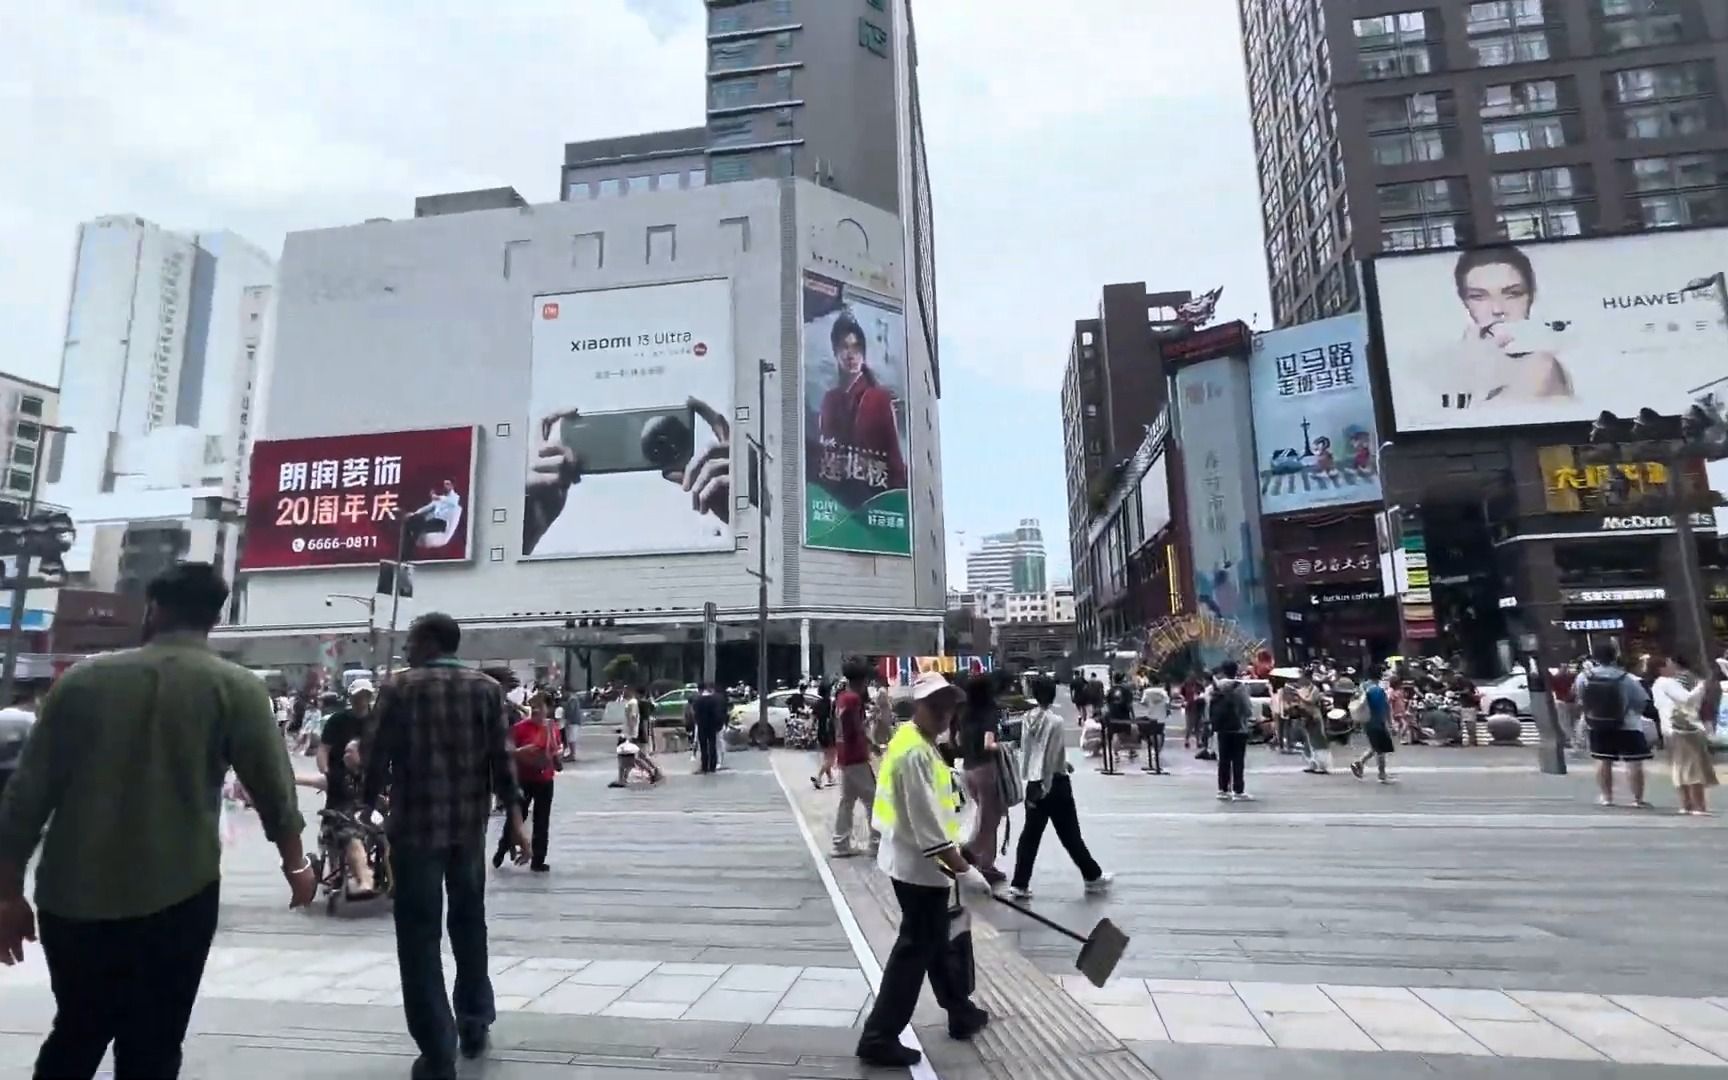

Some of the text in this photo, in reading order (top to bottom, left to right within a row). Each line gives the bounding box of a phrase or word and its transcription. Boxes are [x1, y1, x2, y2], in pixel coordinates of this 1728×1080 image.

[1602, 291, 1685, 309] HUAWEI
[570, 331, 692, 352] xiaomi 13 Ultra
[1275, 341, 1354, 380] 过马路
[1277, 367, 1355, 397] 走斑马线
[278, 455, 402, 492] 朗润装饰
[275, 490, 400, 526] 20周年庆
[307, 535, 378, 551] 6666-0811
